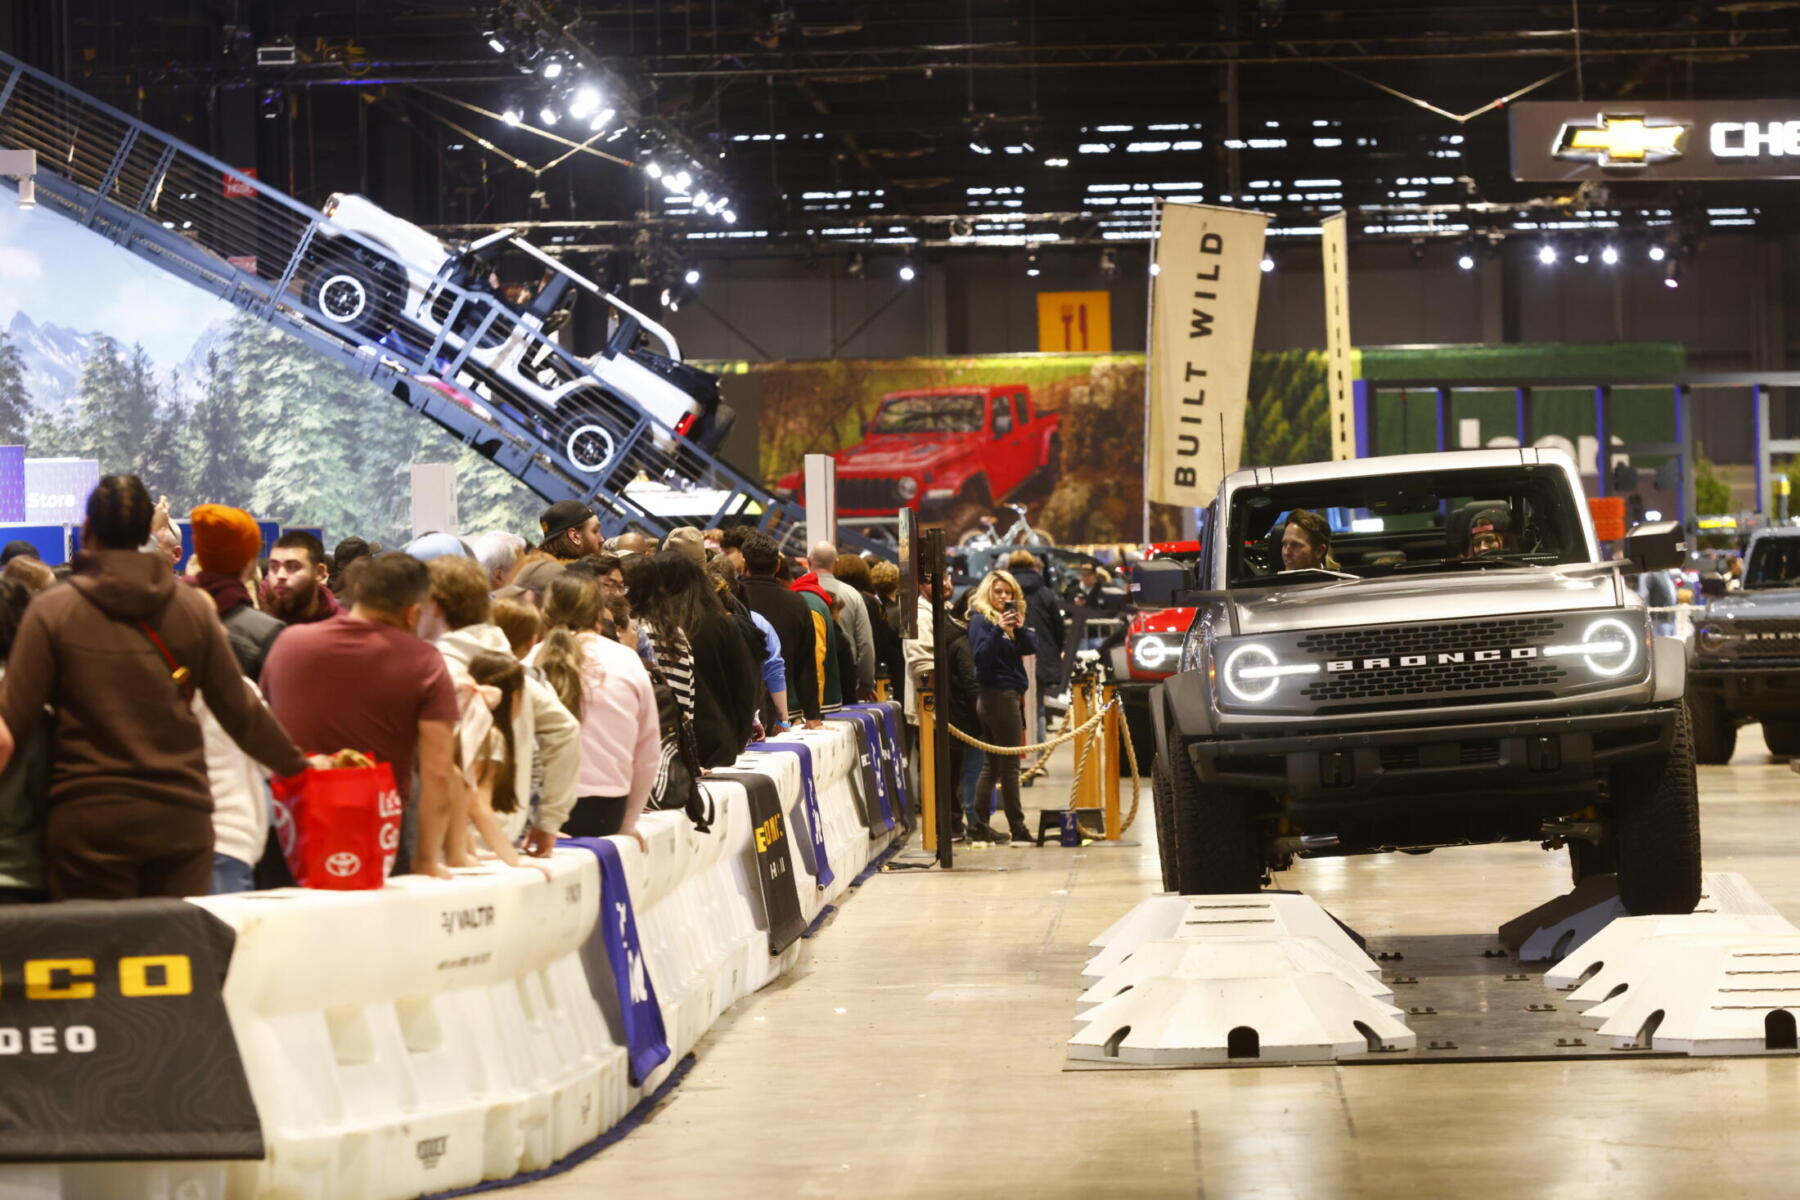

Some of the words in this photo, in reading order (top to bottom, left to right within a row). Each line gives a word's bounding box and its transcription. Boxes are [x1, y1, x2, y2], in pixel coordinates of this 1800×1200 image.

[1189, 232, 1223, 338] WILD
[1174, 361, 1207, 487] BUILT
[27, 492, 76, 508] Store
[1326, 647, 1537, 672] BRONCO
[0, 954, 194, 999] CO
